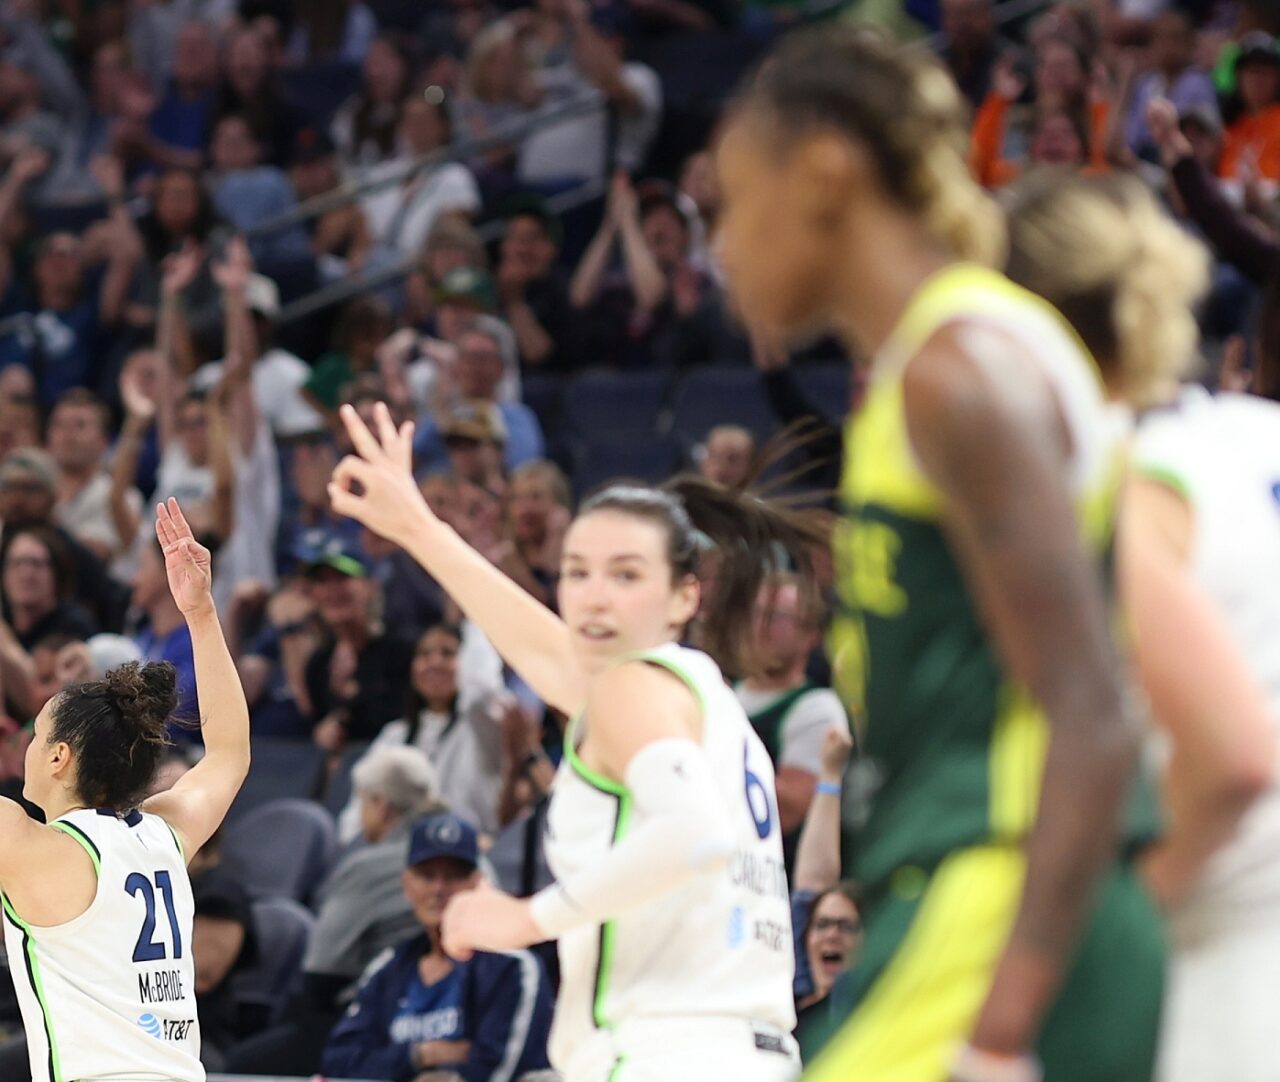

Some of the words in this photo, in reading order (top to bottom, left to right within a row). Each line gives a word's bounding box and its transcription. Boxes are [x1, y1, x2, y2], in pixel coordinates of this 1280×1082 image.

[744, 736, 771, 840] 6
[124, 870, 182, 963] 21
[162, 1018, 195, 1041] AT&T
